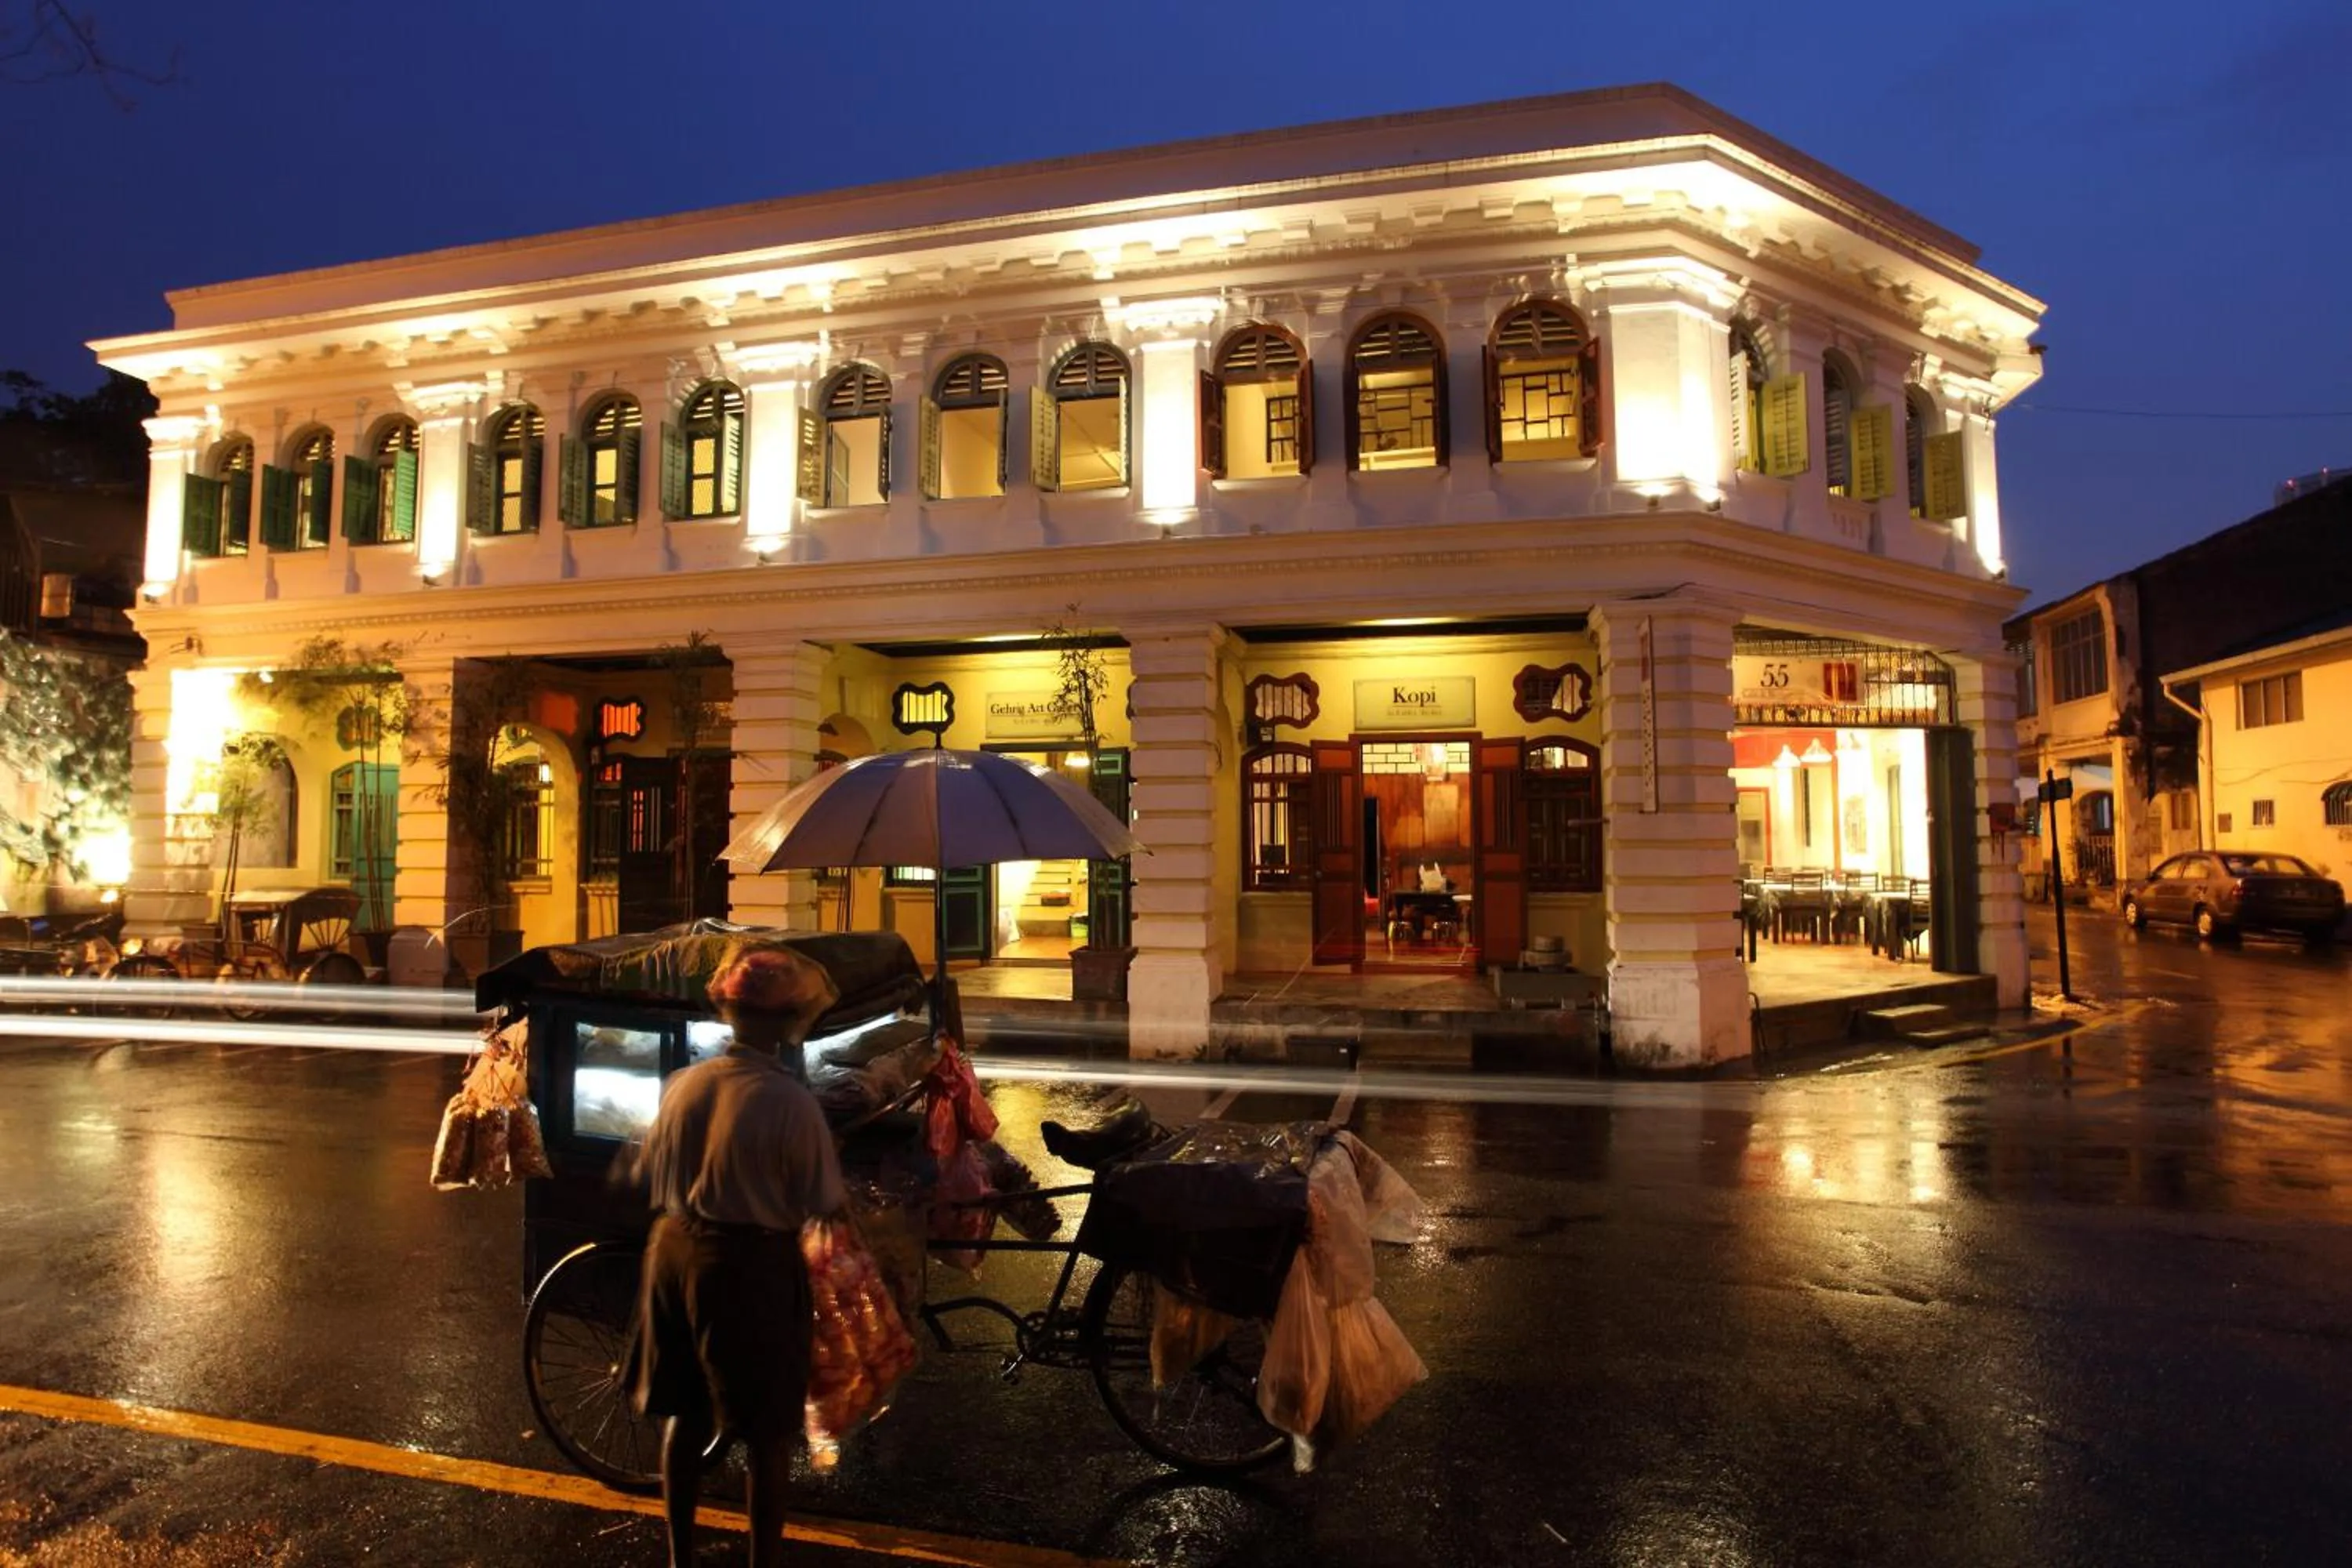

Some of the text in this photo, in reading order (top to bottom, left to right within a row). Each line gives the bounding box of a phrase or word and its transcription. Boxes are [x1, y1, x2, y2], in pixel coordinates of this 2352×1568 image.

[1760, 663, 1789, 688] 55
[1392, 685, 1436, 707] Kopi
[990, 702, 1025, 715] Gehrig
[1028, 702, 1044, 713] Art
